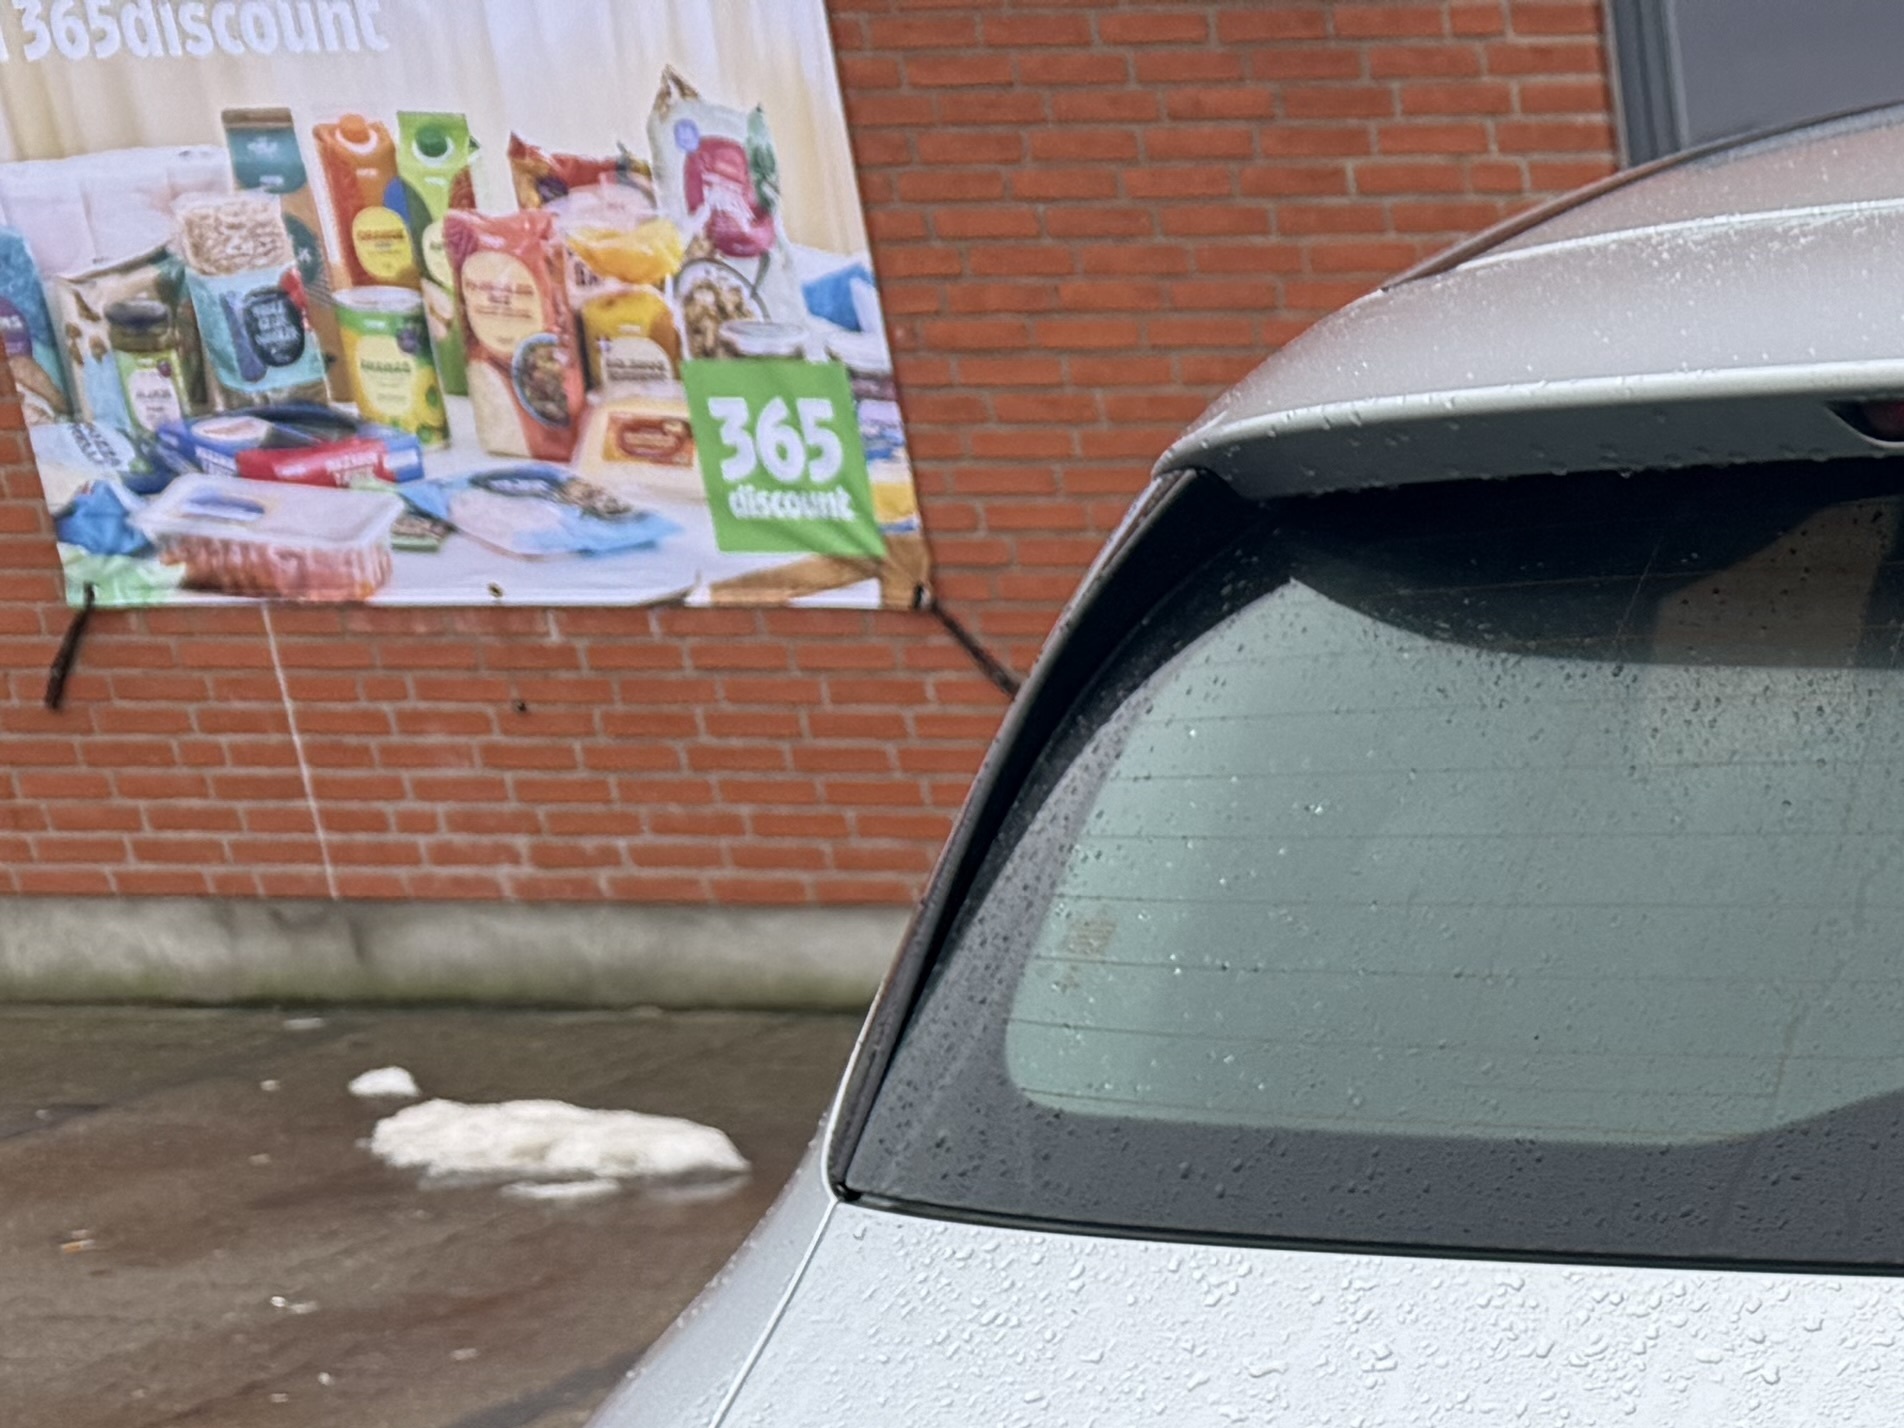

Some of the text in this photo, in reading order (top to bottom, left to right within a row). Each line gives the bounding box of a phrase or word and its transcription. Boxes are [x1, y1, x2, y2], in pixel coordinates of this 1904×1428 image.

[12, 0, 390, 62] 365discount
[707, 396, 843, 484] 365
[729, 485, 856, 522] discount
